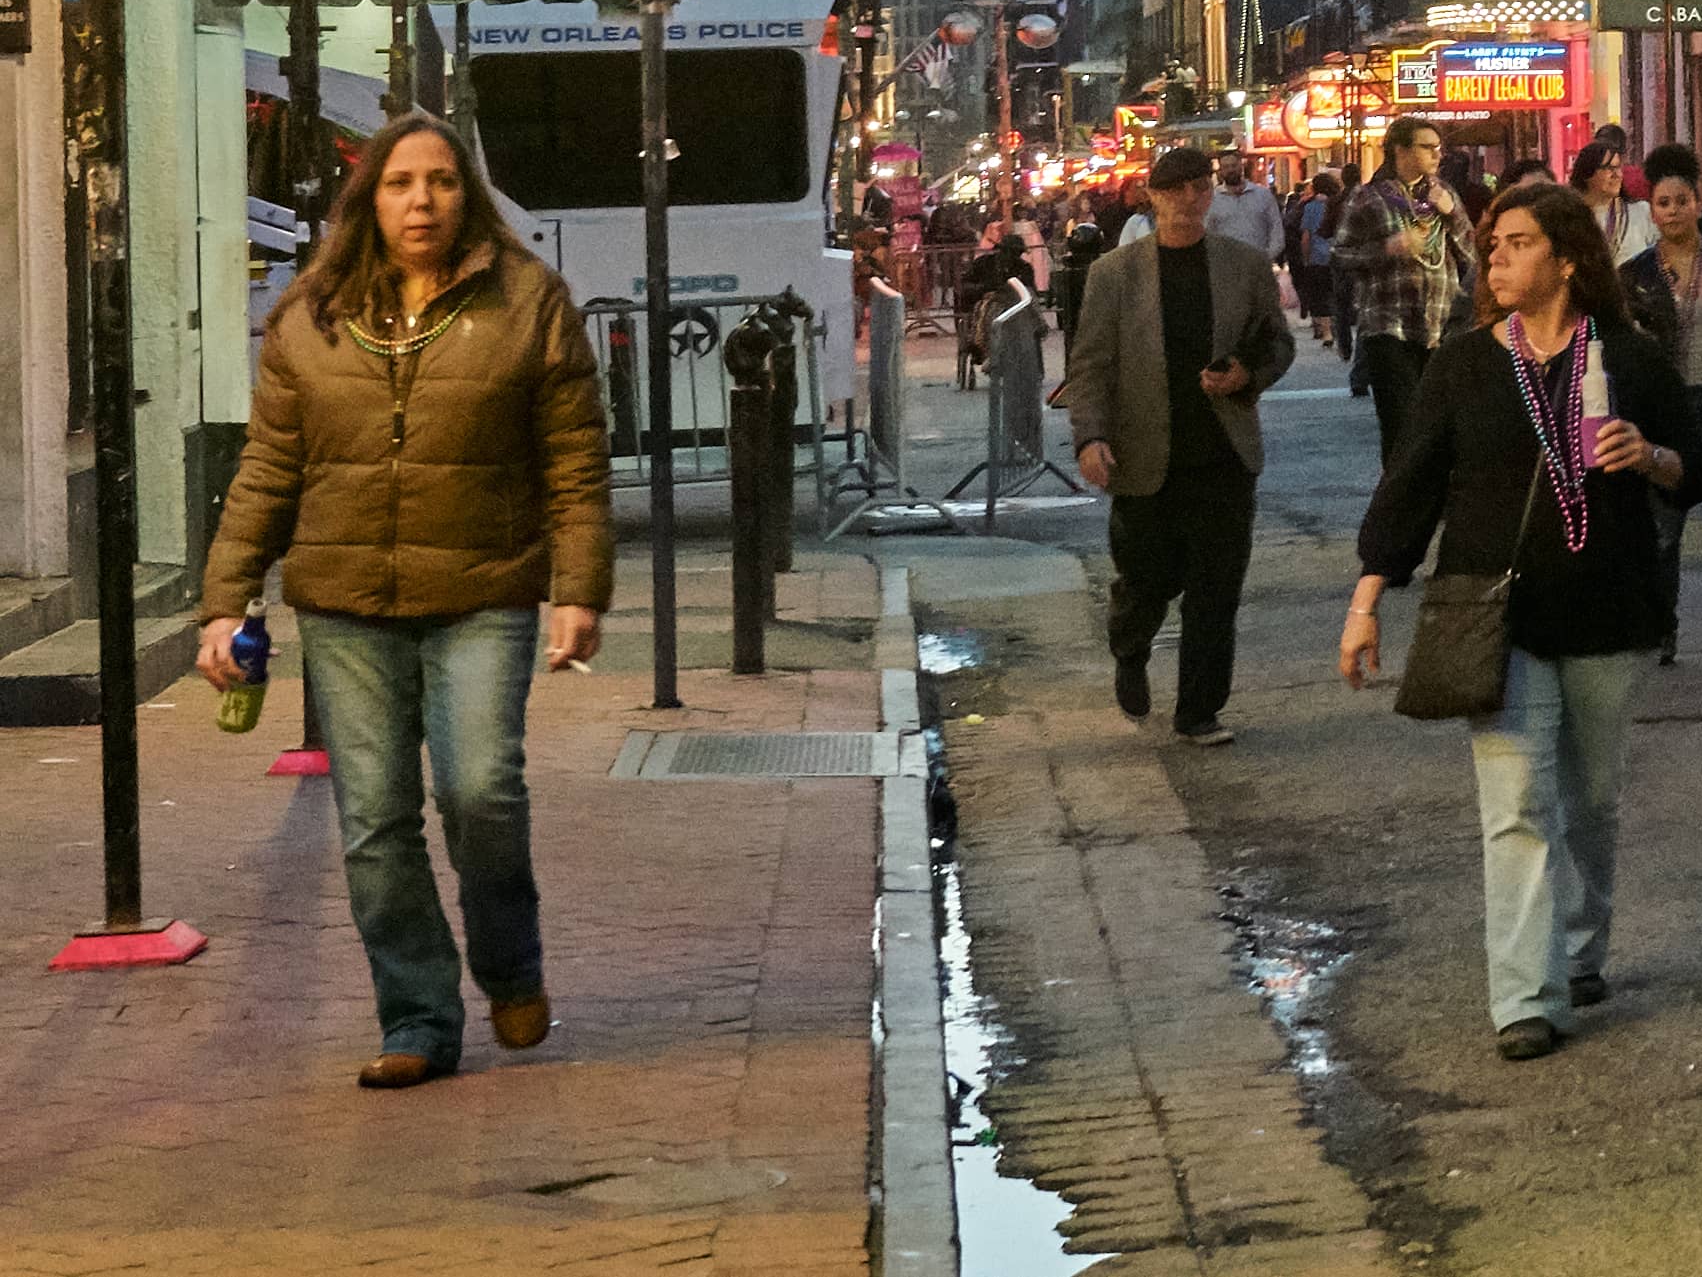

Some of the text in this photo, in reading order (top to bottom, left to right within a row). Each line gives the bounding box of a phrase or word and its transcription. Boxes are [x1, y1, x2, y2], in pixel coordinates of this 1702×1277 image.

[470, 23, 805, 44] NEW ORLEAS POLICE
[1475, 57, 1531, 70] HUSTLER
[1445, 75, 1491, 102] BARELY
[1494, 74, 1532, 101] LEGAL
[1534, 74, 1565, 100] CLUB
